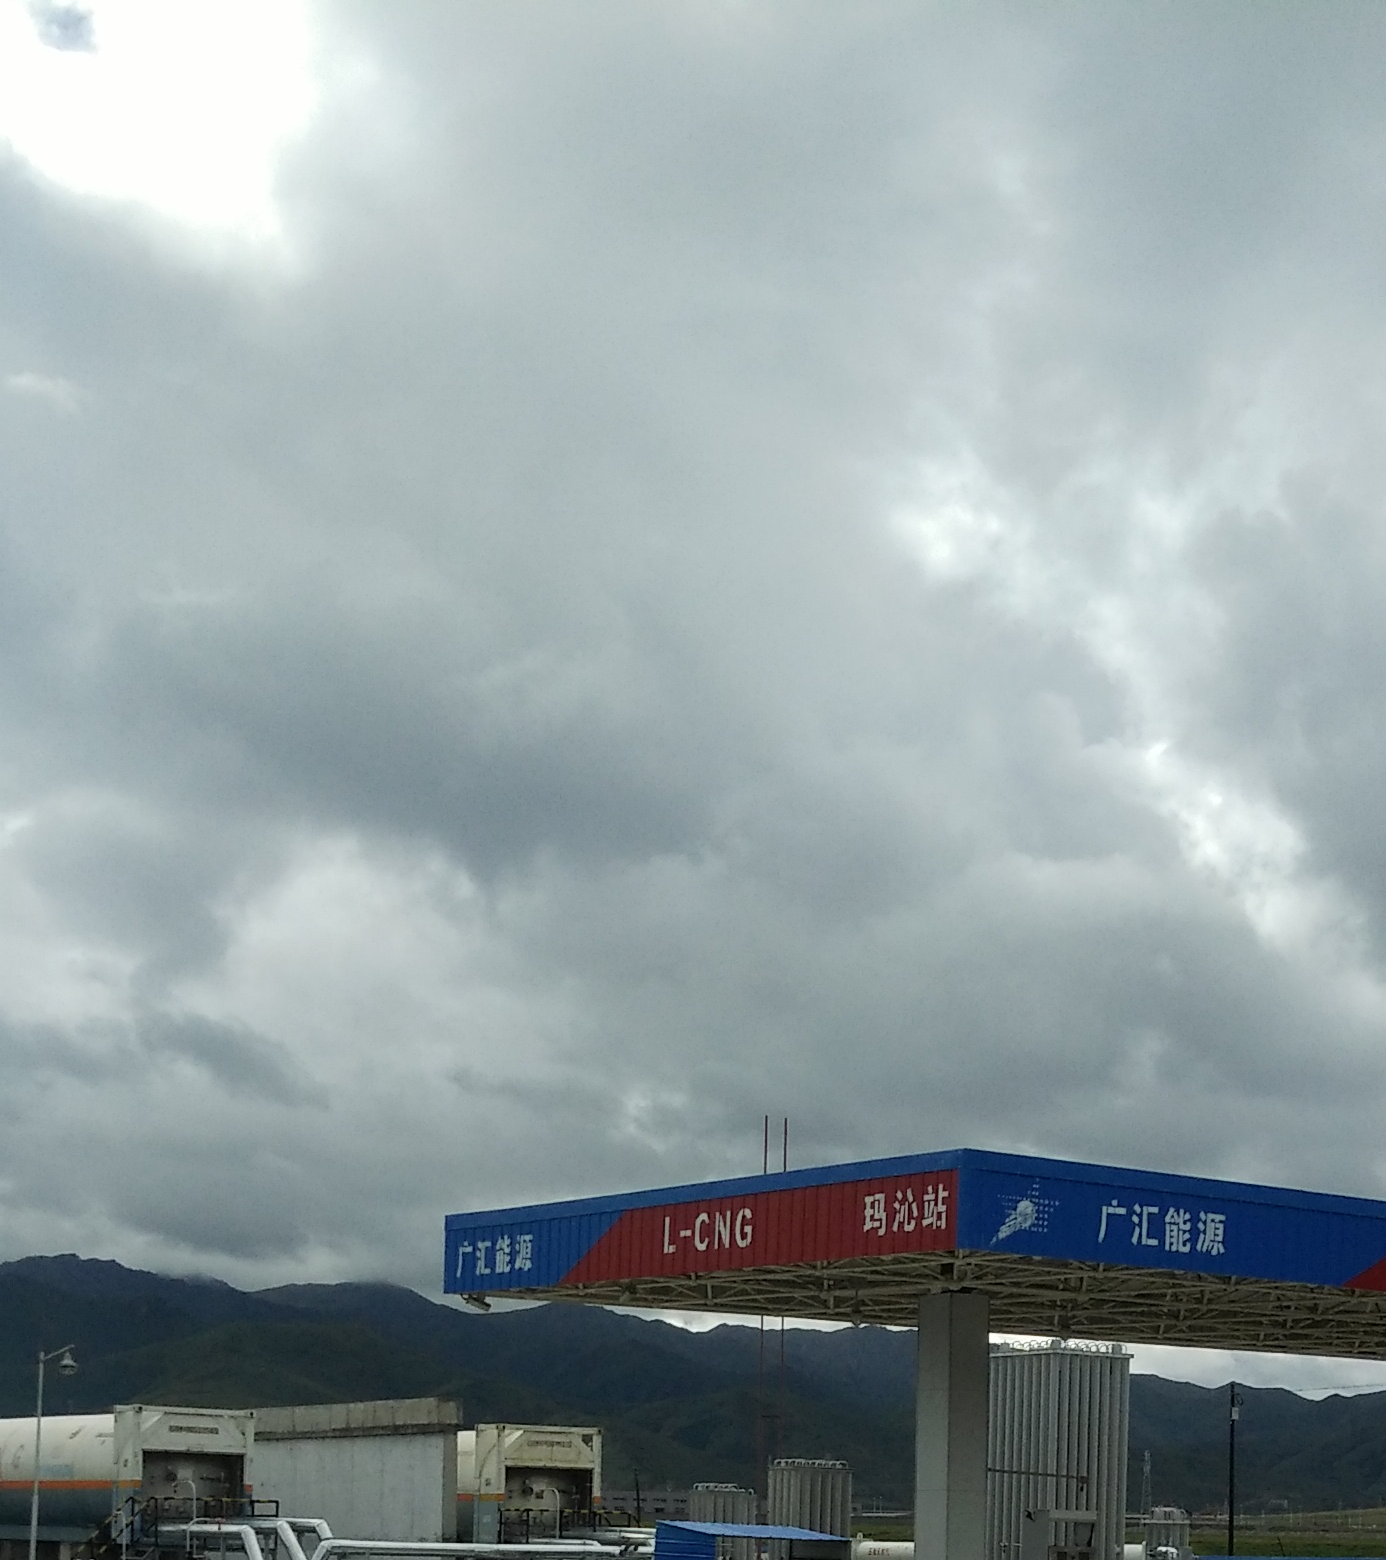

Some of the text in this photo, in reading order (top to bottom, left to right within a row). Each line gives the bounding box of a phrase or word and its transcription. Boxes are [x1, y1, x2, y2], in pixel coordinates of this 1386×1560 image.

[663, 1207, 753, 1254] L-CNG
[863, 1183, 949, 1236] 玛沁站
[1097, 1199, 1226, 1256] 广汇能源
[456, 1234, 534, 1278] 广汇能源
